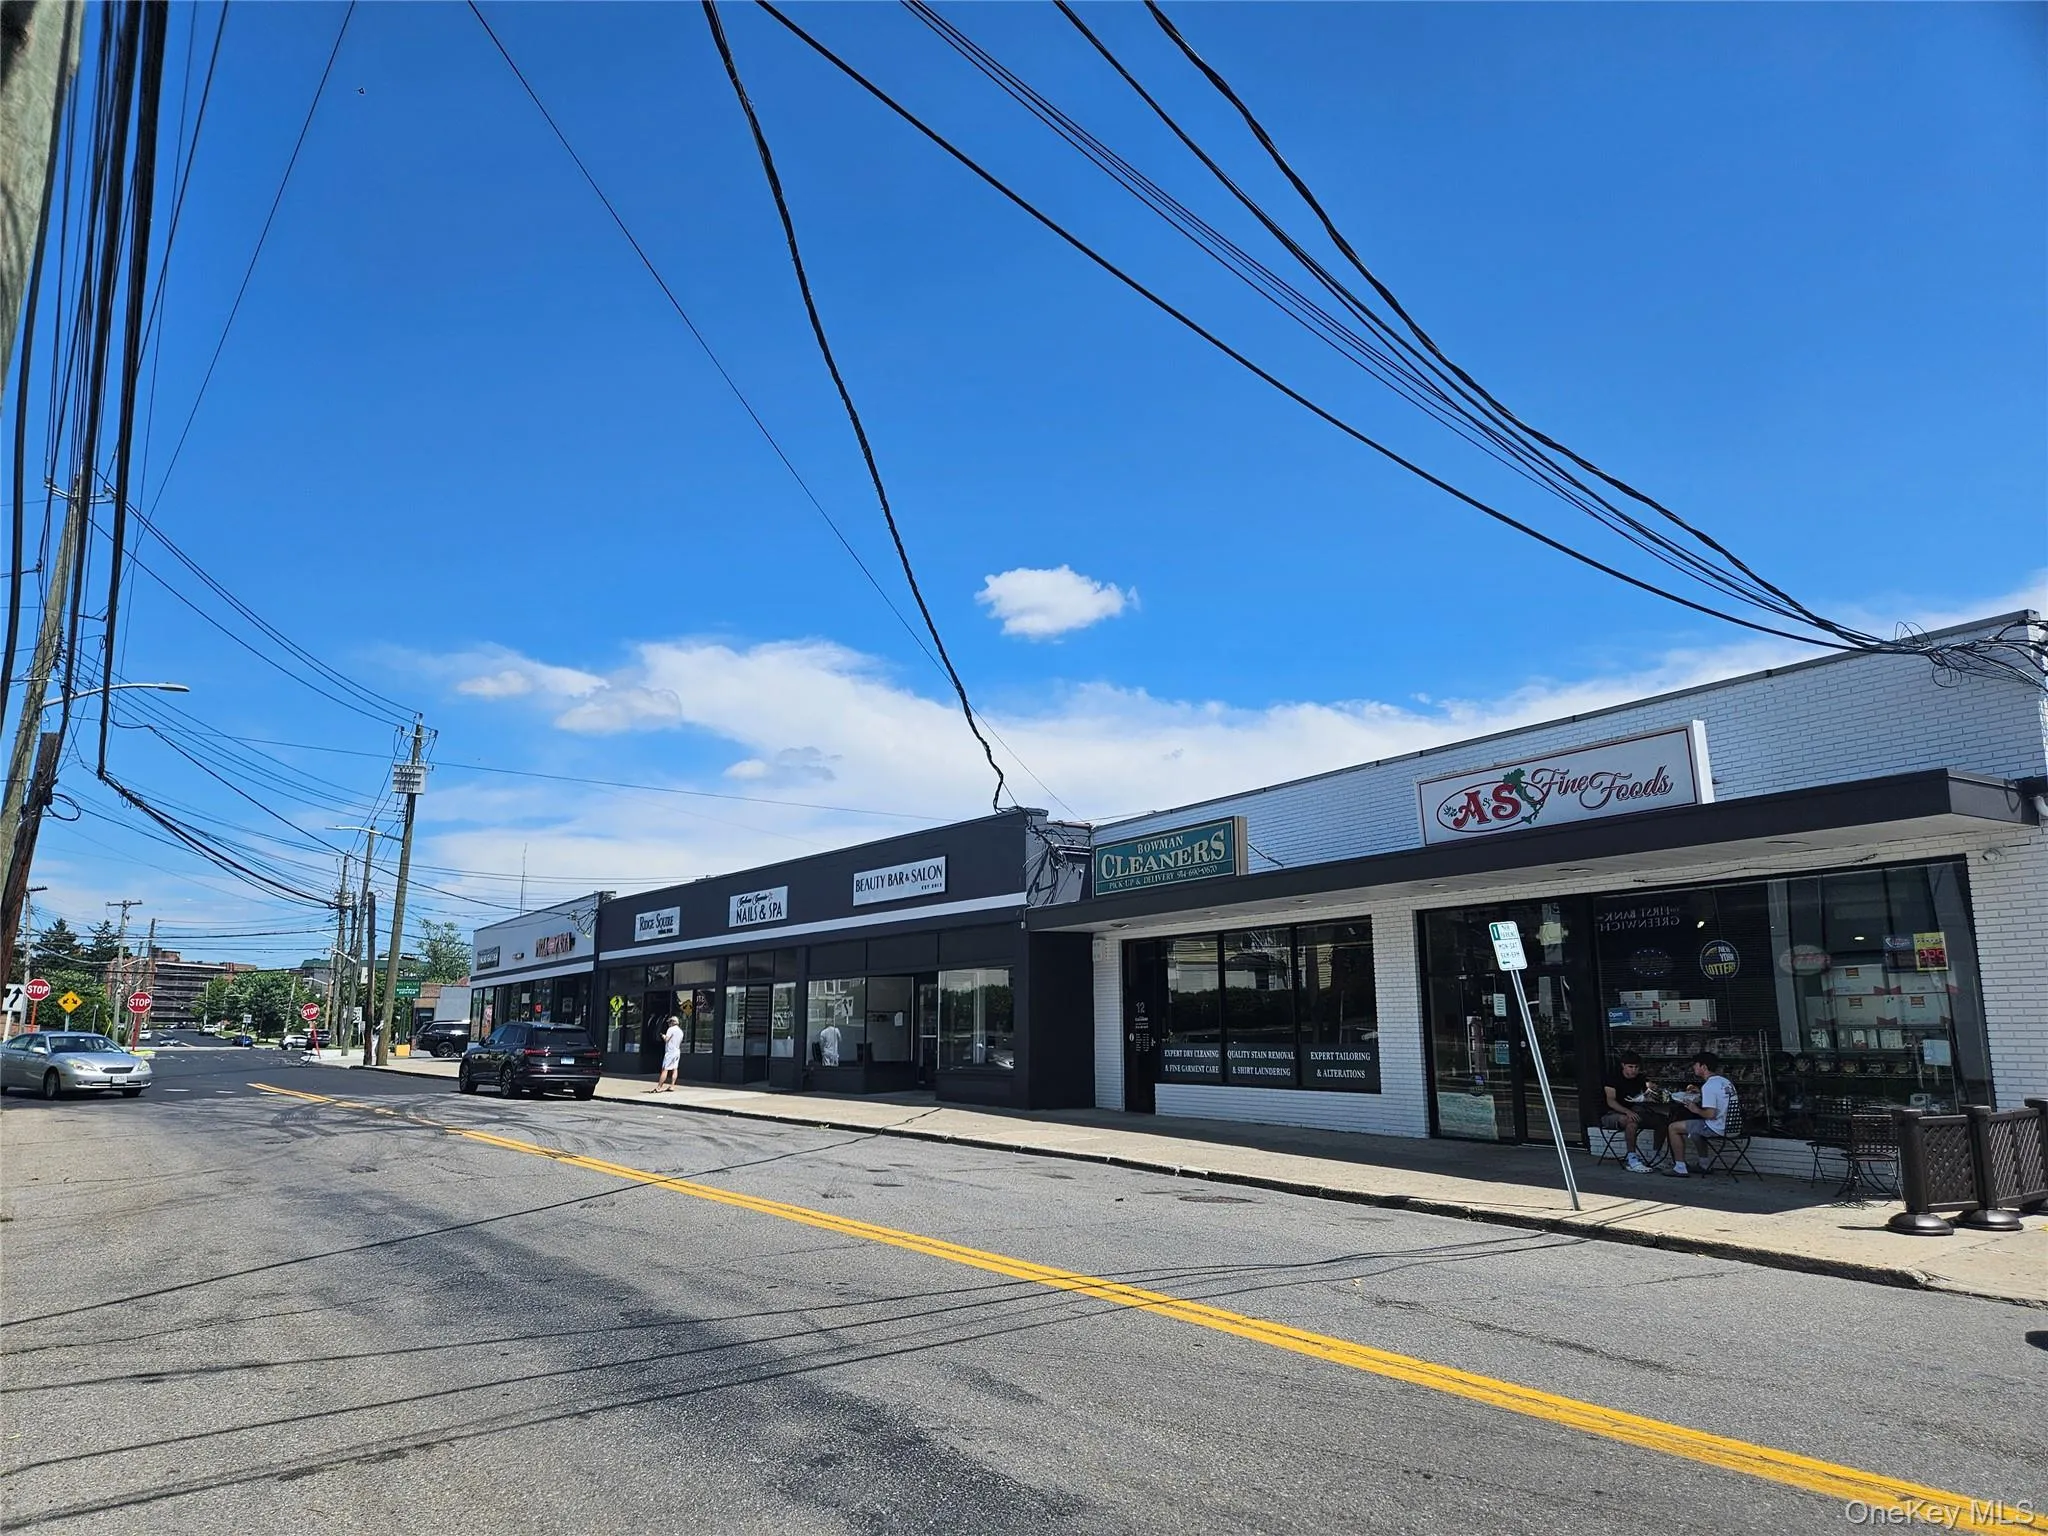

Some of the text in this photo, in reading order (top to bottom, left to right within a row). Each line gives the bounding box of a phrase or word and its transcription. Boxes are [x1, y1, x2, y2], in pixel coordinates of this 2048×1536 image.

[1531, 767, 1590, 808] Fine
[1579, 764, 1674, 810] Foods
[1137, 836, 1183, 854] BOWMAN
[1101, 828, 1226, 879] CLEANERS
[855, 864, 943, 893] BEAUTY BAR & SALON
[1109, 879, 1134, 890] PICK-UP
[1143, 872, 1174, 884] DELIVERY
[736, 905, 758, 924] NAILS
[759, 904, 767, 920] &
[769, 901, 783, 919] SPA
[26, 986, 49, 994] STOP
[129, 998, 150, 1006] STOP
[303, 1007, 318, 1016] STOP
[1164, 1049, 1219, 1058] EXPERT DRY CLEANING
[1227, 1050, 1295, 1060] QUALITY STAIN REMOVAL
[1310, 1051, 1371, 1061] EXPERT TAILORING
[1181, 1065, 1205, 1073] GARMENT
[1205, 1065, 1219, 1073] CARE
[1237, 1067, 1254, 1075] SHIRT
[1254, 1067, 1291, 1076] LAUNDERING
[1316, 1068, 1366, 1078] & ALTERATIONS
